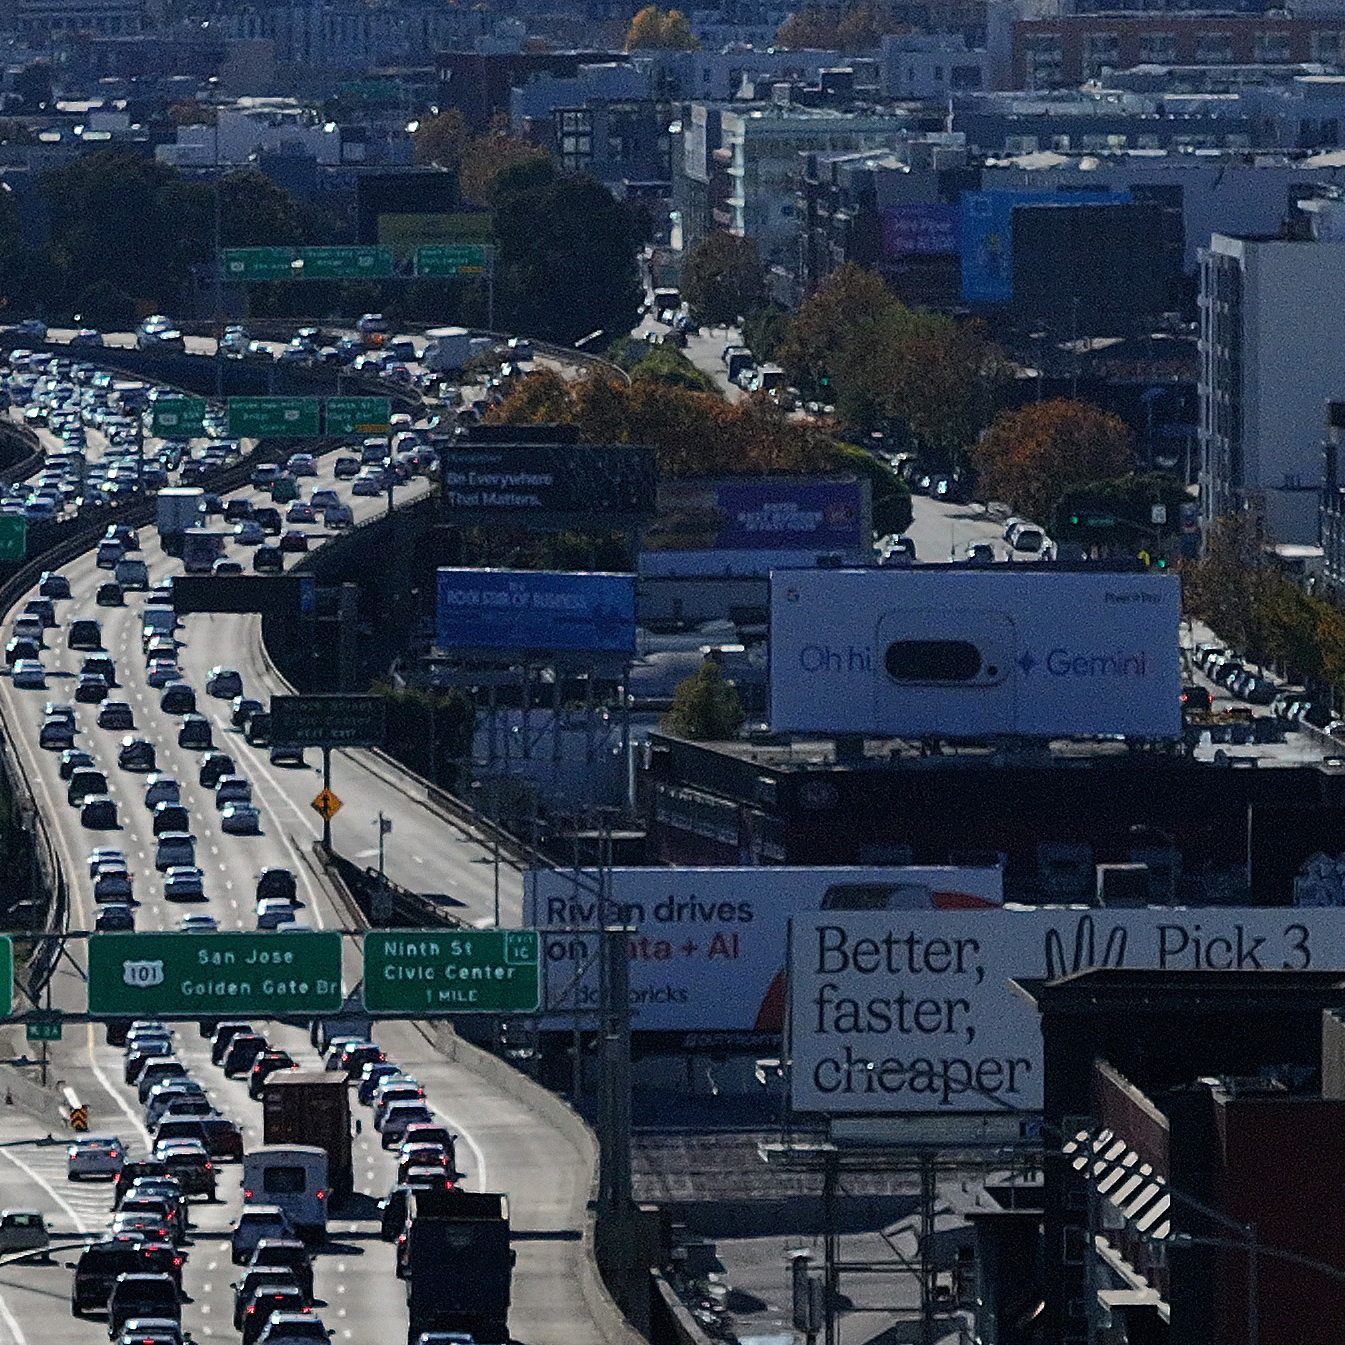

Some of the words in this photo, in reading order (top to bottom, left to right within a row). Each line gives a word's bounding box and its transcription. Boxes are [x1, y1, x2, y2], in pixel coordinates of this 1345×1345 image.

[469, 471, 554, 489] Everywhere
[448, 491, 479, 506] That
[799, 645, 842, 674] Oh
[1045, 648, 1148, 678] Gemini
[546, 894, 646, 925] Rivian
[653, 893, 755, 925] drives
[384, 941, 441, 957] Ninth
[450, 941, 473, 957] St
[547, 938, 589, 961] on
[708, 932, 741, 960] AI
[814, 924, 985, 985] Better,
[1156, 924, 1267, 969] Pick
[1282, 924, 1312, 970] 3
[197, 949, 236, 965] San
[244, 949, 295, 965] Jose
[130, 966, 158, 982] 101
[384, 964, 436, 981] Civic
[444, 964, 517, 981] Center
[180, 980, 252, 996] Golden
[262, 979, 309, 995] Gate
[315, 980, 338, 995] Br
[426, 990, 433, 1003] 1
[438, 990, 479, 1003] MILE
[813, 982, 976, 1043] faster,
[813, 1046, 1034, 1107] cheaper
